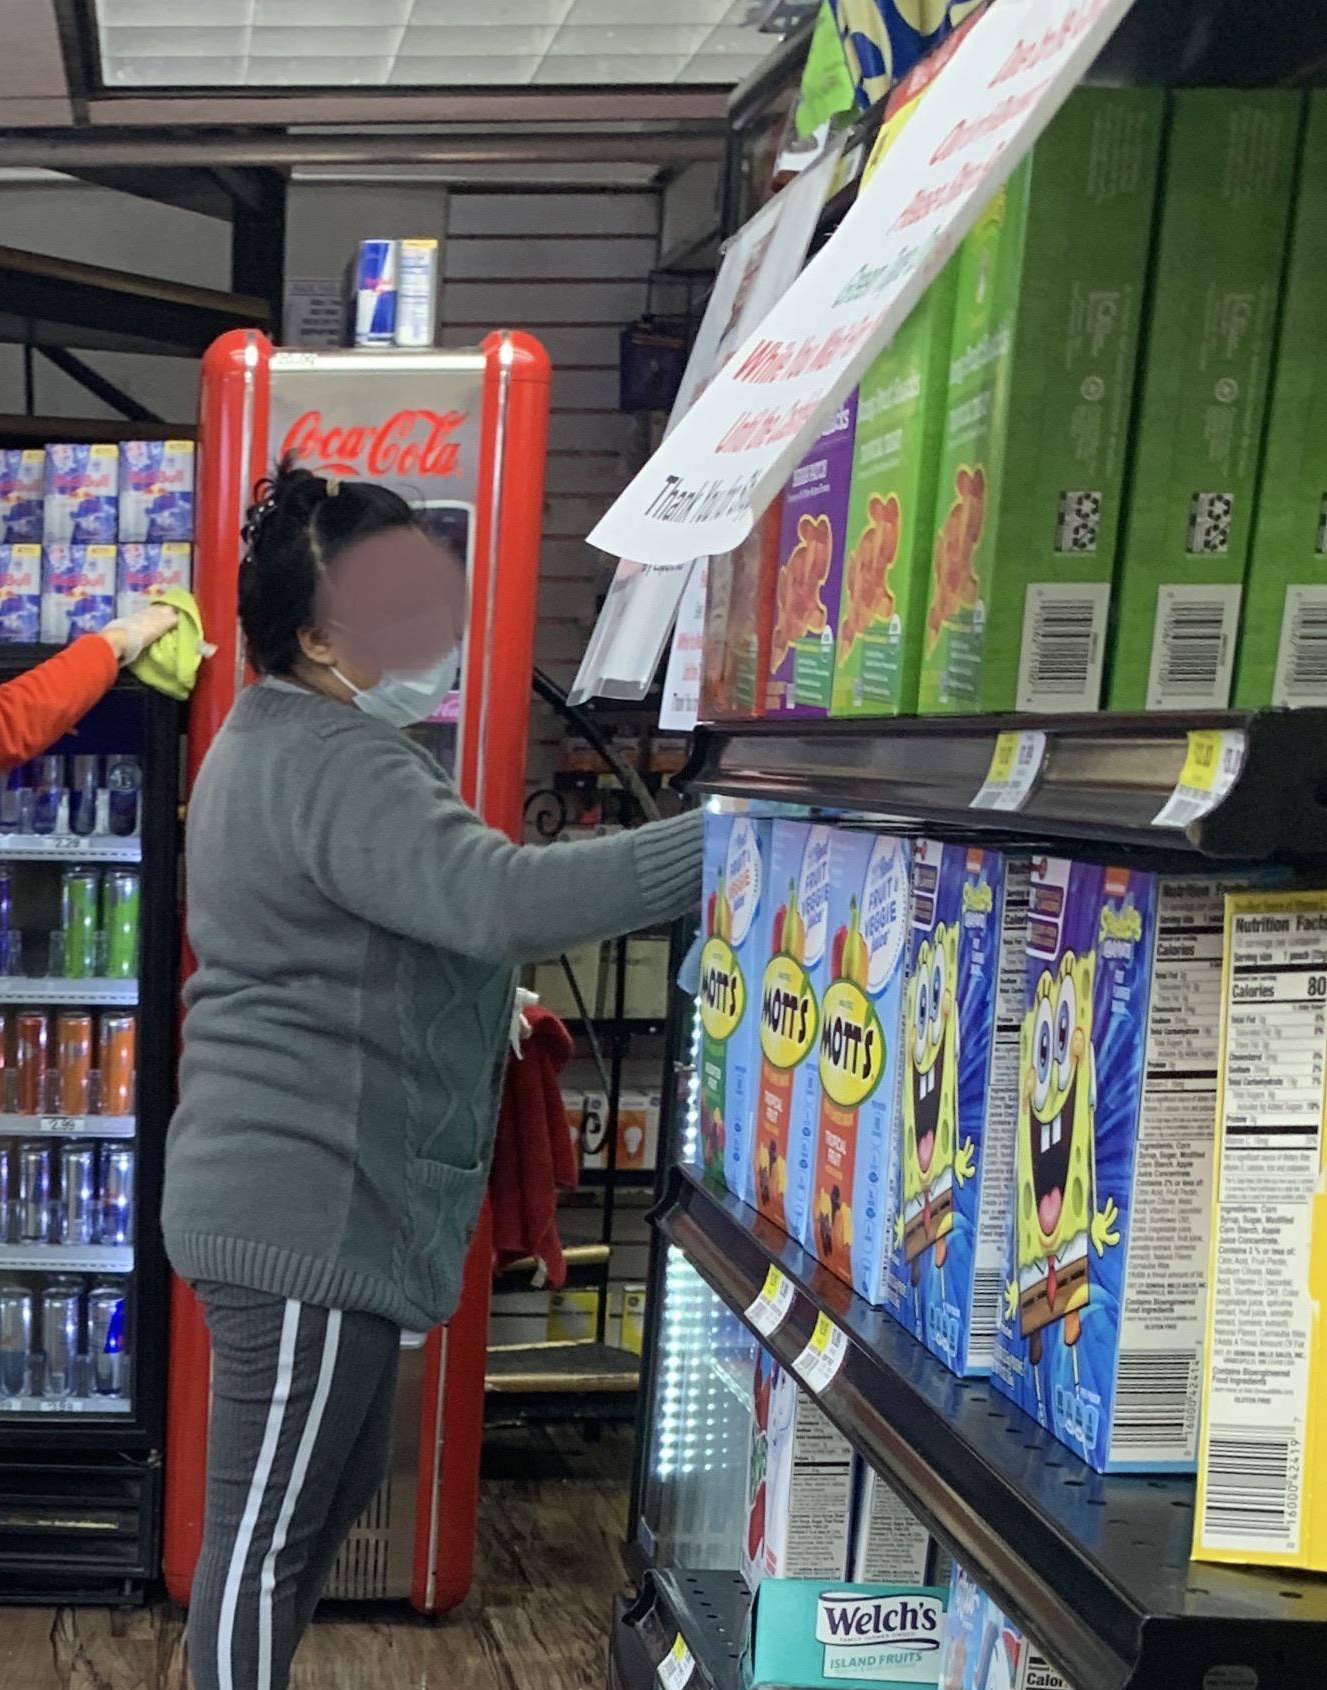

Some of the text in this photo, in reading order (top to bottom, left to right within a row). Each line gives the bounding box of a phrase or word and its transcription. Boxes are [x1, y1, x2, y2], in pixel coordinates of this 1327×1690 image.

[733, 338, 794, 384] While
[280, 409, 469, 477] Coca-Cola
[644, 475, 709, 523] Thank
[868, 874, 895, 911] FRUIT
[864, 903, 897, 938] VEGGIE
[1235, 916, 1290, 933] Nutrition
[1156, 943, 1195, 957] Calories
[701, 967, 738, 1018] MOTT'S
[1233, 976, 1327, 998] Calories 80
[760, 987, 809, 1044] MOTT'S
[821, 1016, 875, 1080] MOTT'S
[822, 1601, 937, 1636] Welch's
[830, 1651, 922, 1670] ISLAND FRUITS
[1026, 1672, 1069, 1688] Calor
